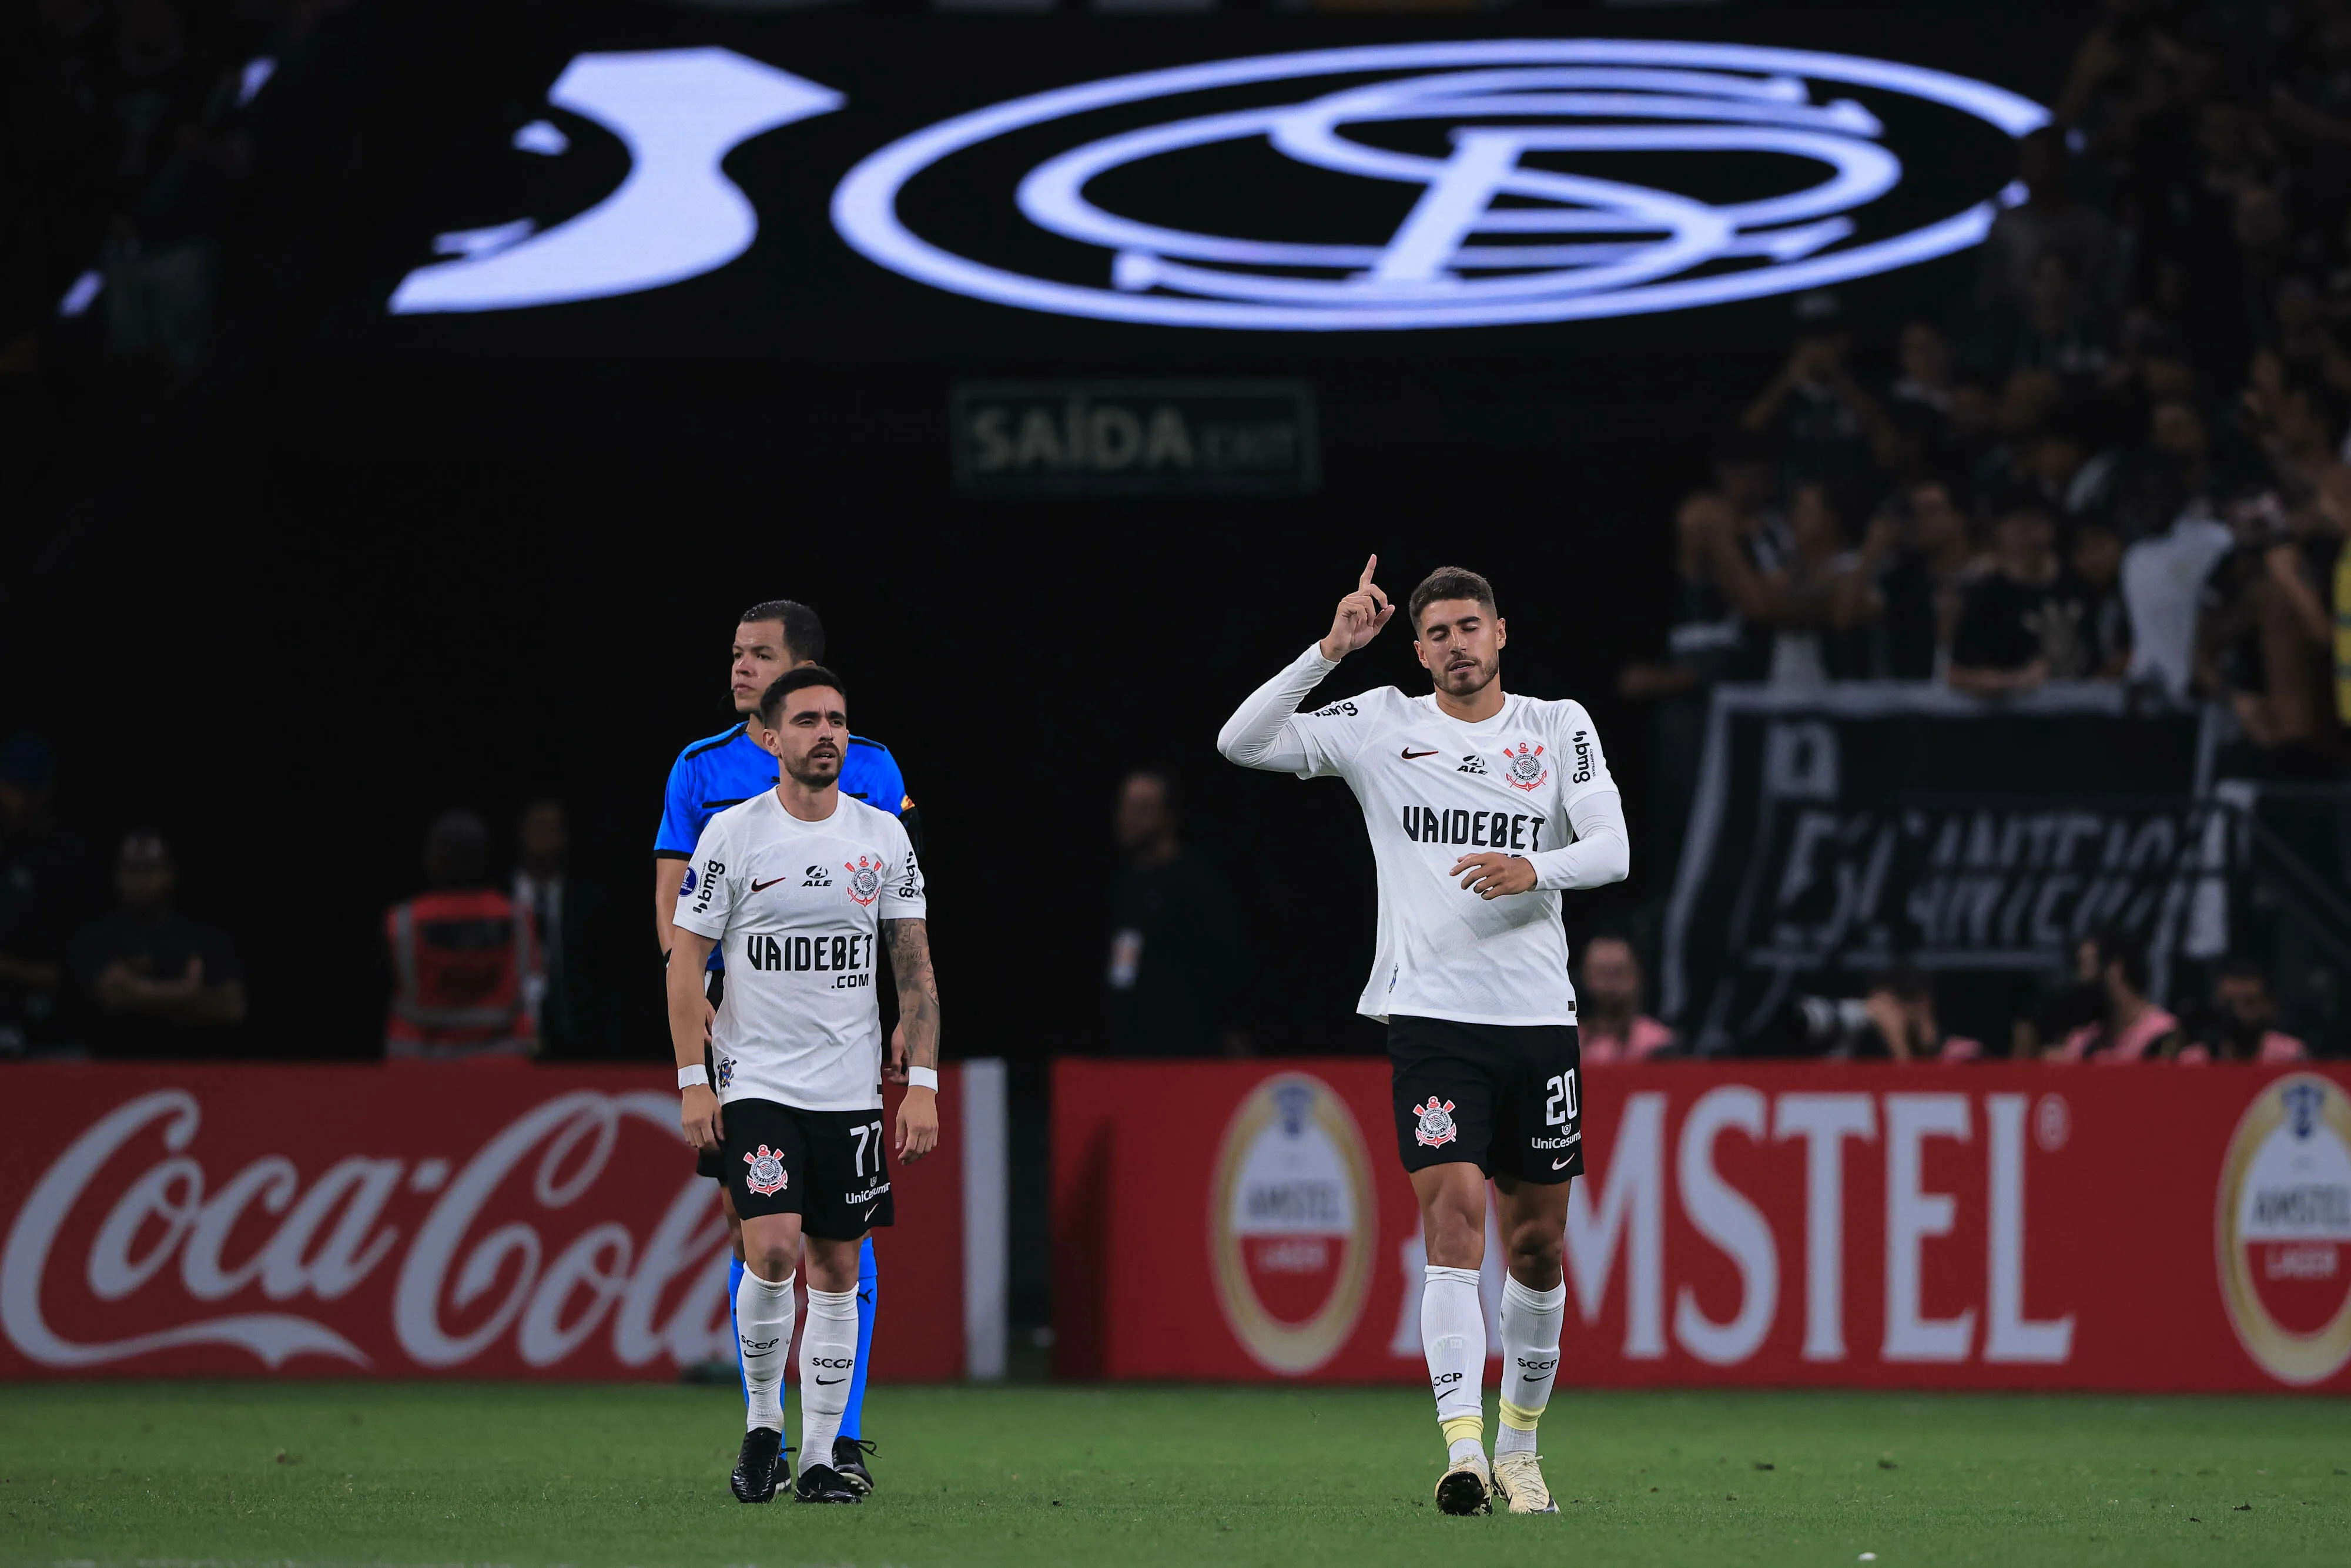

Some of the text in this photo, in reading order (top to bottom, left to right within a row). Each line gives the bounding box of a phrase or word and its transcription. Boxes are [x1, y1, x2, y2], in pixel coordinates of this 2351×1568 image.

[1456, 765, 1488, 775] ALE
[1572, 742, 1590, 784] bmg
[1403, 806, 1545, 852] VAIDEBET
[698, 859, 725, 902] bmg
[747, 934, 873, 971] VAIDEBET
[831, 973, 869, 989] .COM
[1546, 1068, 1578, 1126] 20
[849, 1120, 882, 1177] 77
[1532, 1129, 1582, 1149] UniCesum
[741, 1335, 779, 1349] SCCP
[812, 1357, 853, 1369] SCCP
[1518, 1358, 1558, 1370] SCCP
